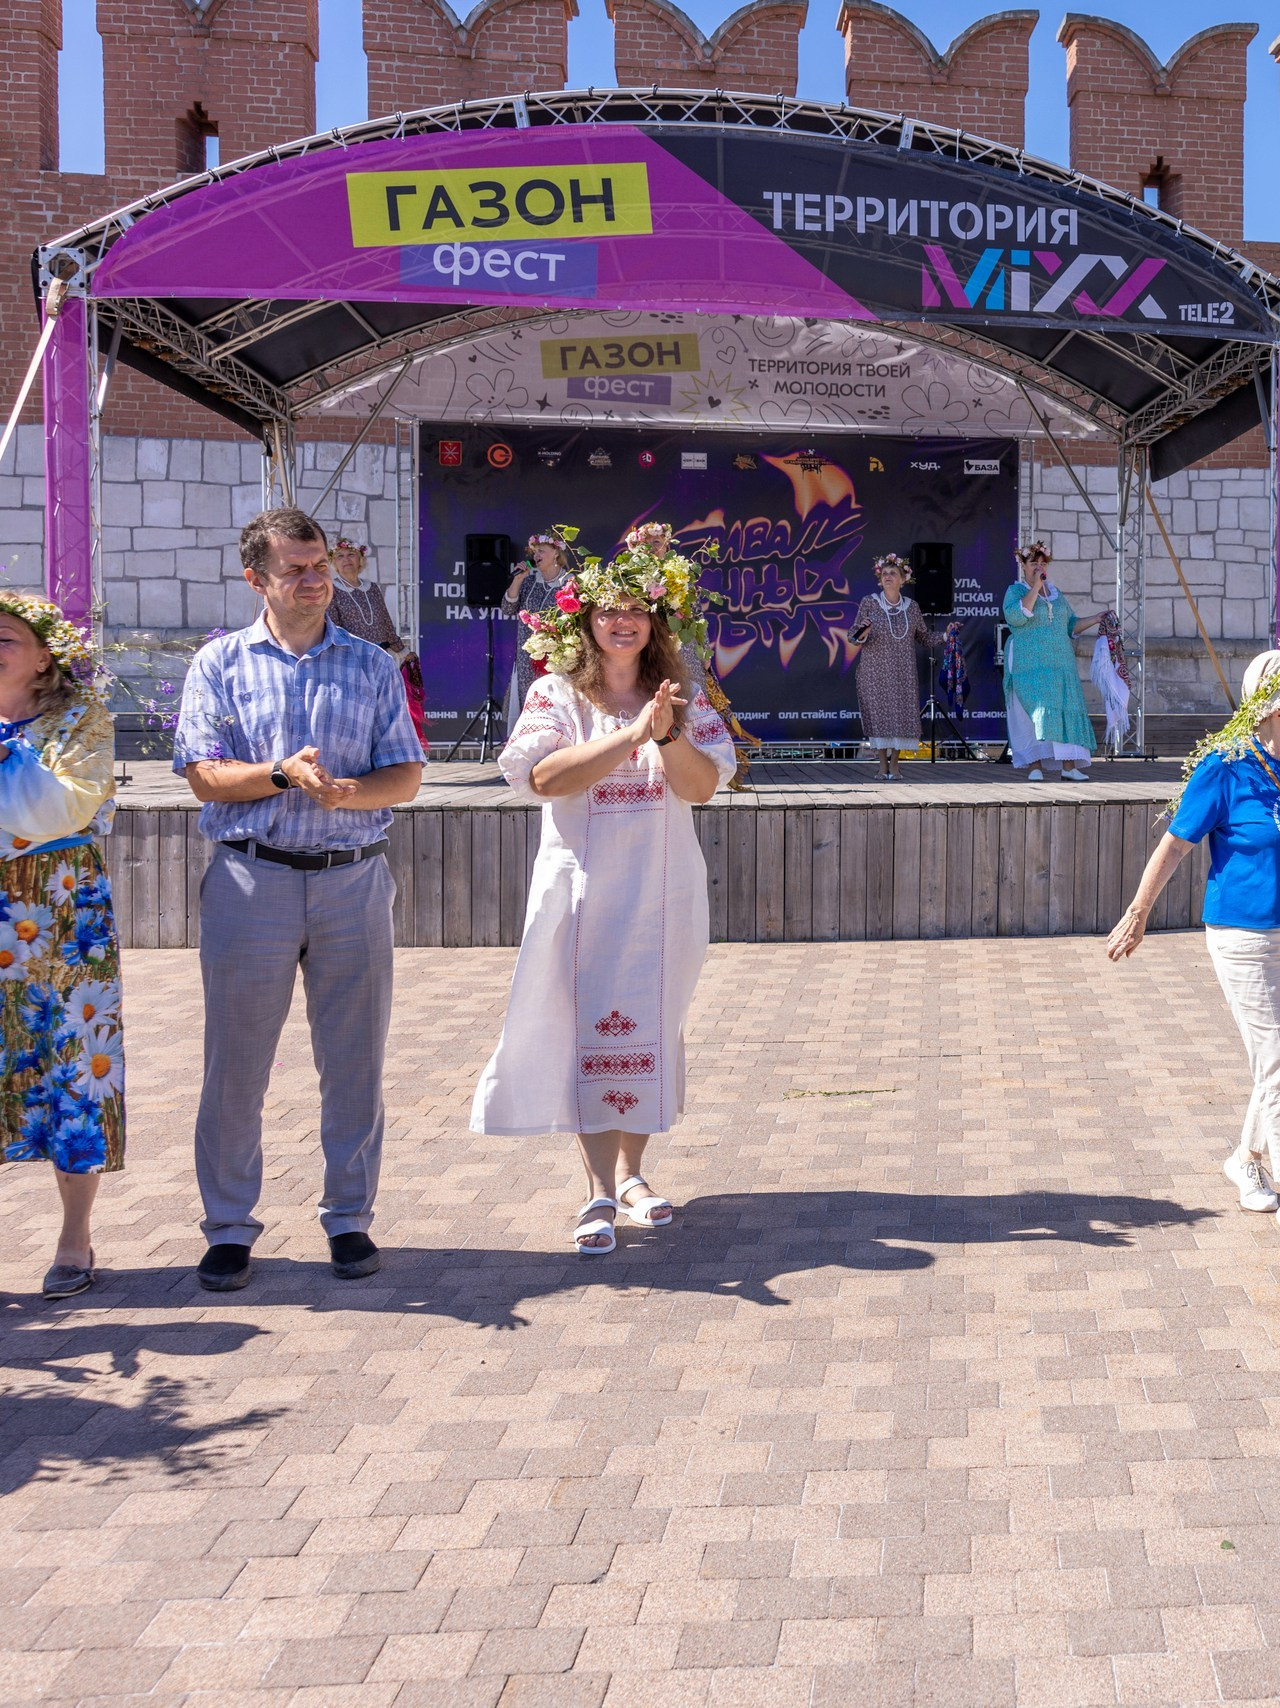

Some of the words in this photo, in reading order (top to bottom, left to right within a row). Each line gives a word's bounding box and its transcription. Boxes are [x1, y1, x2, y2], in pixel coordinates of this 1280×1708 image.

[385, 178, 616, 231] ГАЗОН
[763, 191, 1078, 245] ТЕРРИТОРИЯ
[433, 242, 566, 285] фест
[1179, 301, 1234, 324] TELE2
[560, 341, 681, 371] ГАЗОН
[748, 359, 851, 376] ТЕРРИТОРИЯ
[856, 362, 911, 378] ТВОЕЙ
[584, 376, 655, 399] фест
[774, 380, 886, 398] МОЛОДОСТИ
[954, 578, 981, 589] УЛА,
[954, 593, 993, 602] НСКАЯ
[446, 605, 473, 619] НА
[778, 711, 799, 719] олл
[801, 710, 836, 719] стайлс
